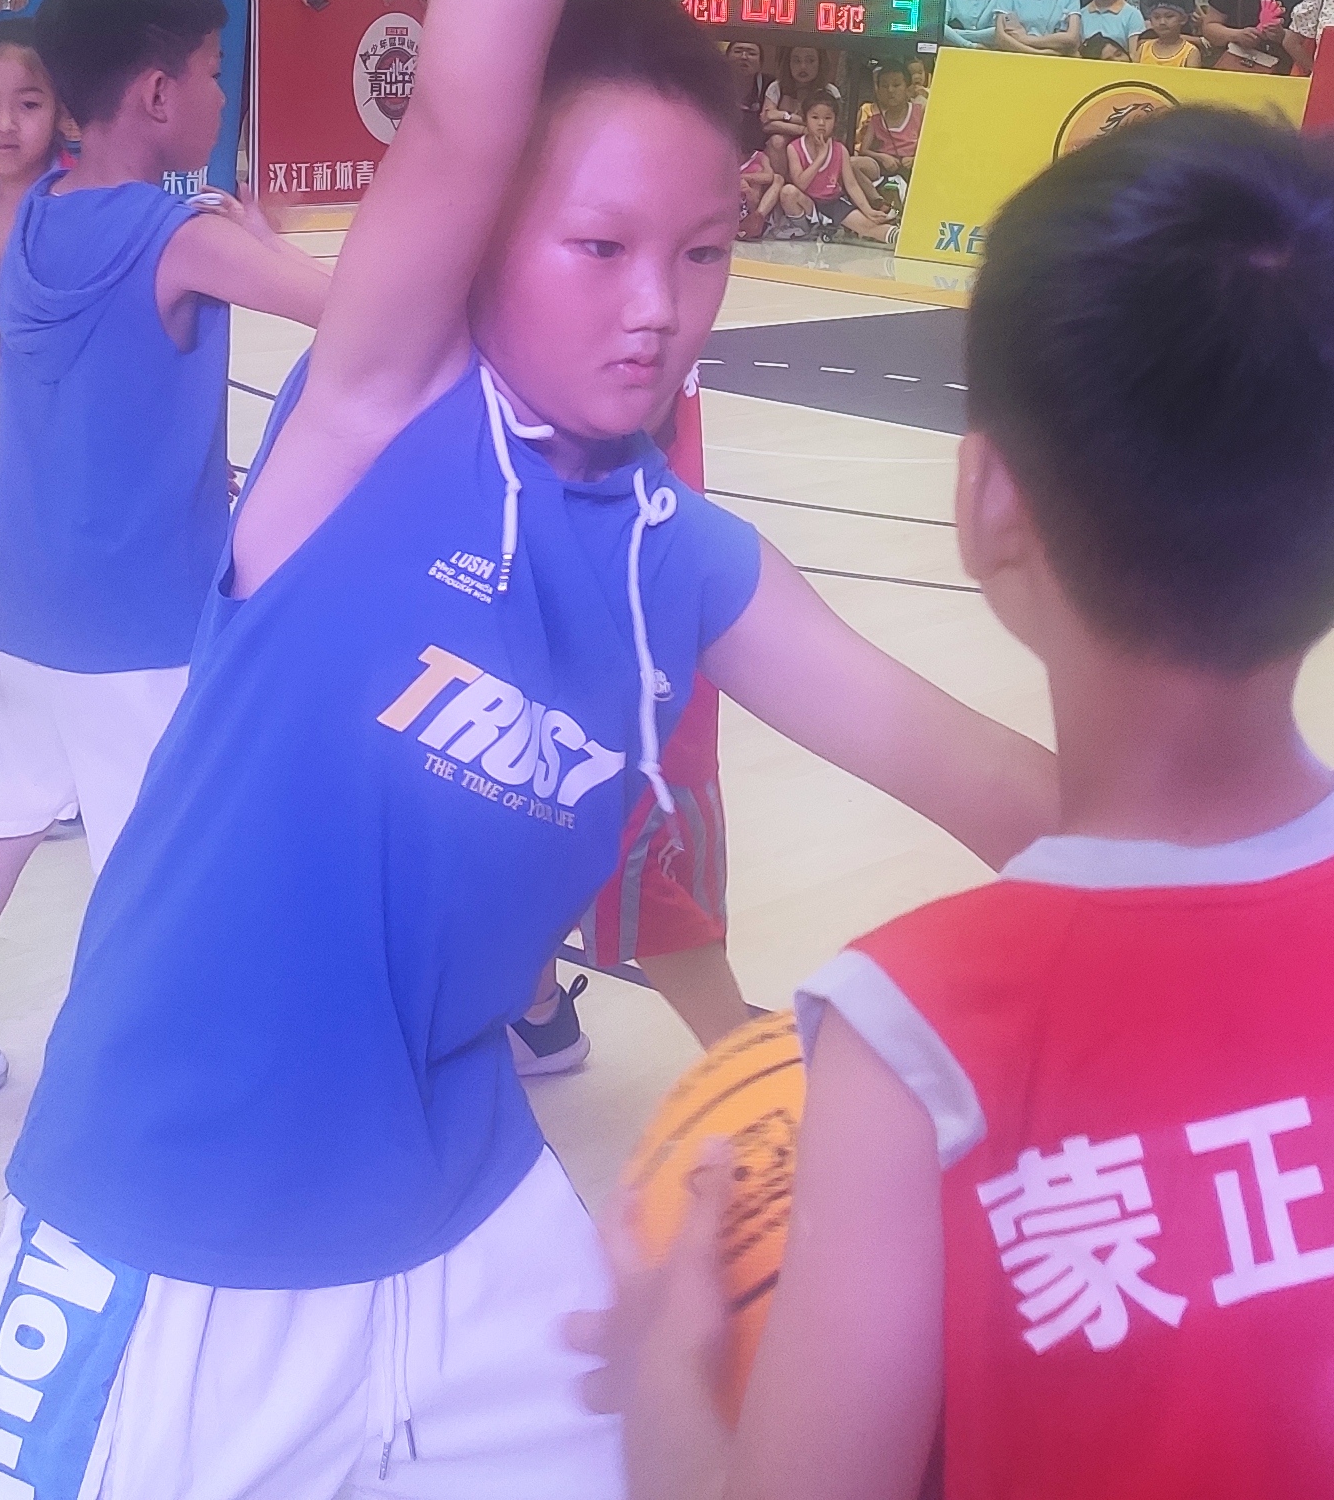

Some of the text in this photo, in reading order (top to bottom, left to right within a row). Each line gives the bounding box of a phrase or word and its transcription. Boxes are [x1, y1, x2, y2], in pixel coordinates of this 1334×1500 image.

[449, 550, 496, 580] LUSH
[423, 752, 458, 782] THE
[460, 769, 506, 803] TIME
[503, 790, 528, 811] OF
